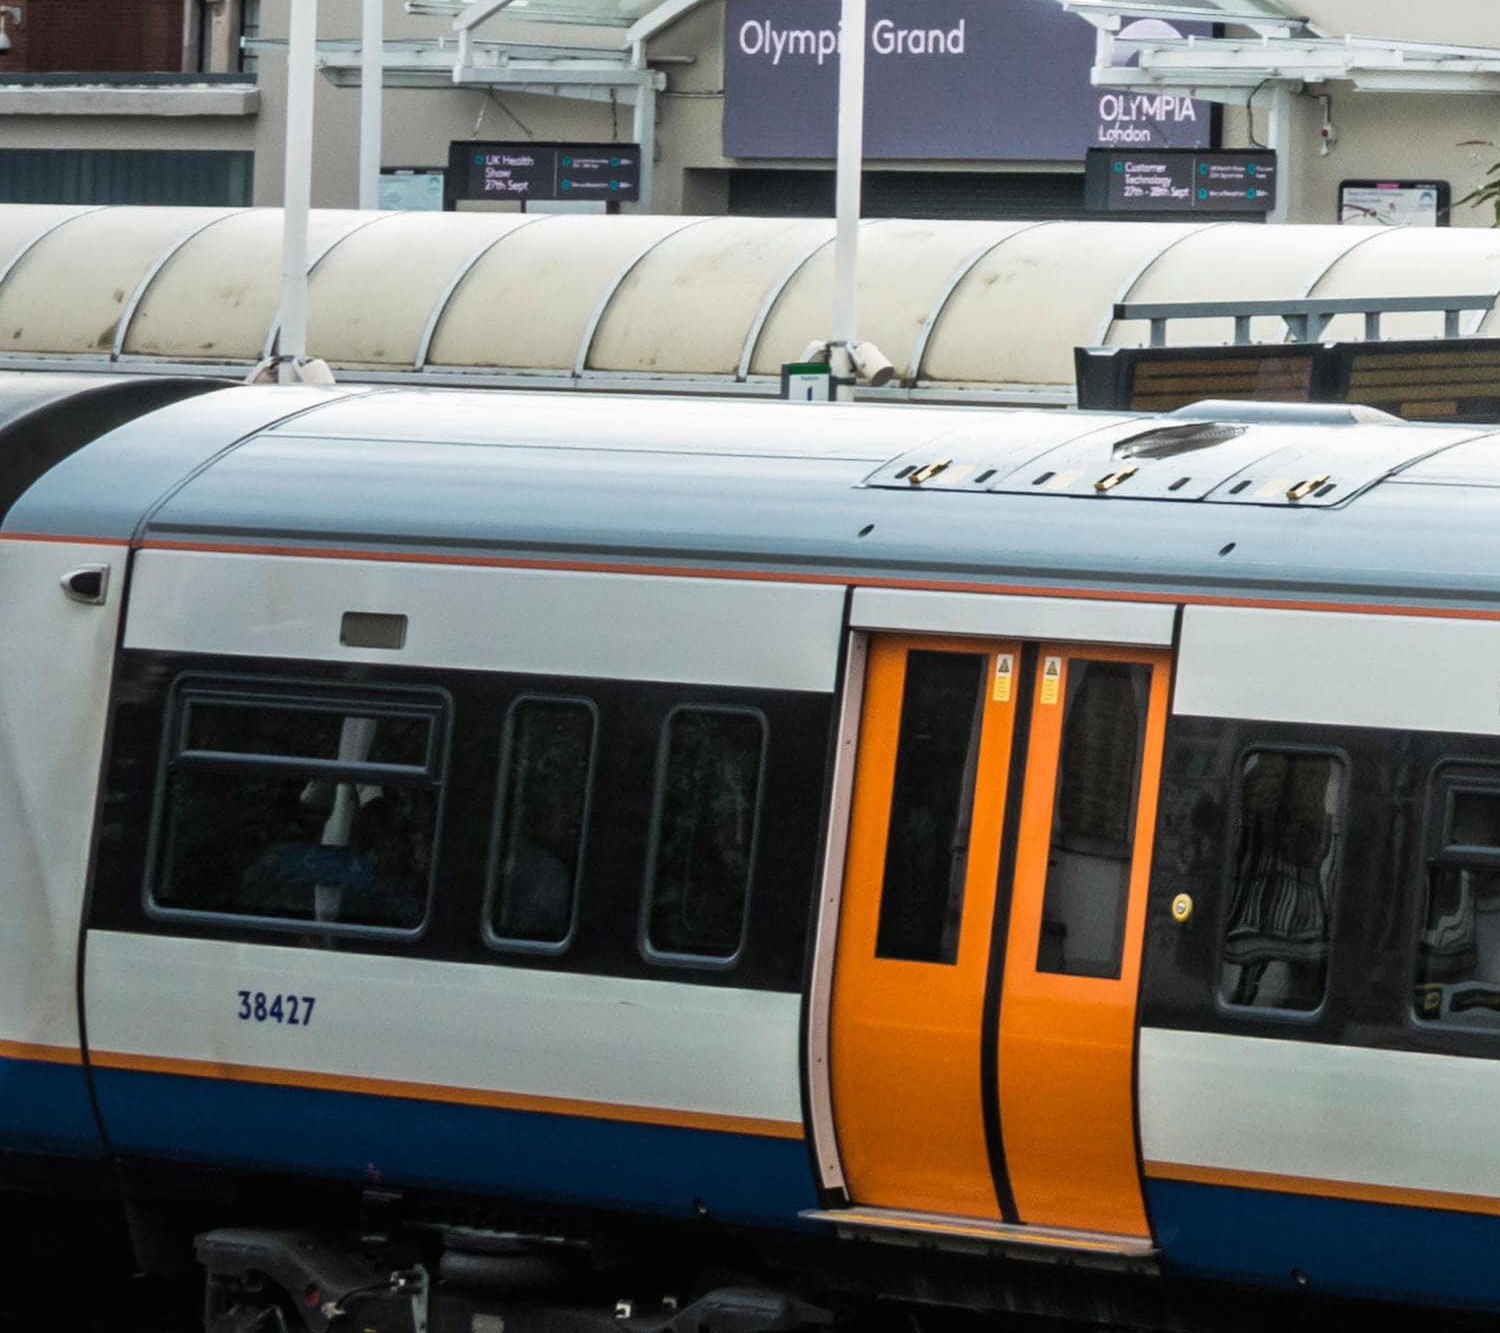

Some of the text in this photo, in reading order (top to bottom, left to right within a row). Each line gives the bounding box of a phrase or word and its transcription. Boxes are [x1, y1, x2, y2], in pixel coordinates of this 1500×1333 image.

[740, 19, 965, 65] Olympi Grand
[1100, 94, 1196, 121] OLYMPIA
[1099, 124, 1150, 142] London
[485, 155, 534, 166] UK Health
[1125, 162, 1167, 173] Customer
[485, 167, 511, 178] Show
[507, 179, 529, 193] Sept
[1125, 174, 1172, 188] Technology
[238, 990, 316, 1026] 38427
